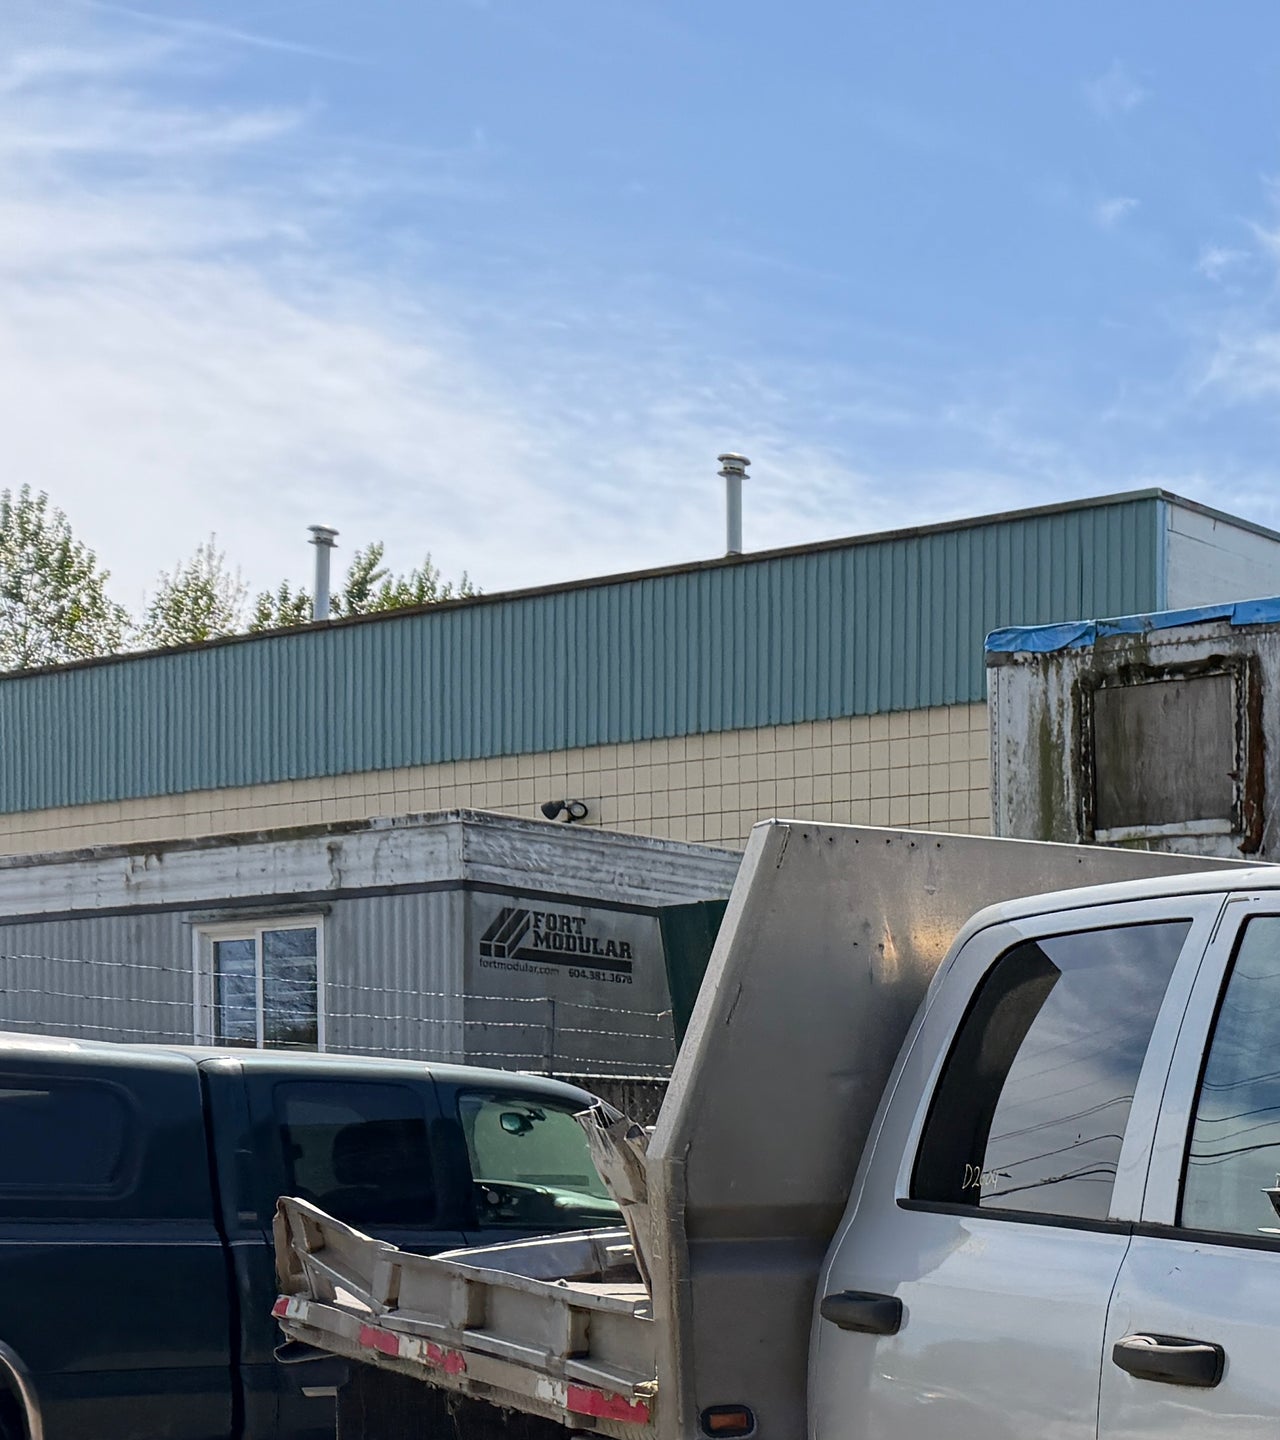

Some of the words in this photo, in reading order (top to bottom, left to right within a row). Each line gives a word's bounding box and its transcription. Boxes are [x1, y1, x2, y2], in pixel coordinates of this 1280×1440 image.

[533, 911, 586, 935] FORT
[533, 930, 632, 960] MODULAR
[479, 958, 560, 977] fortmodular.com
